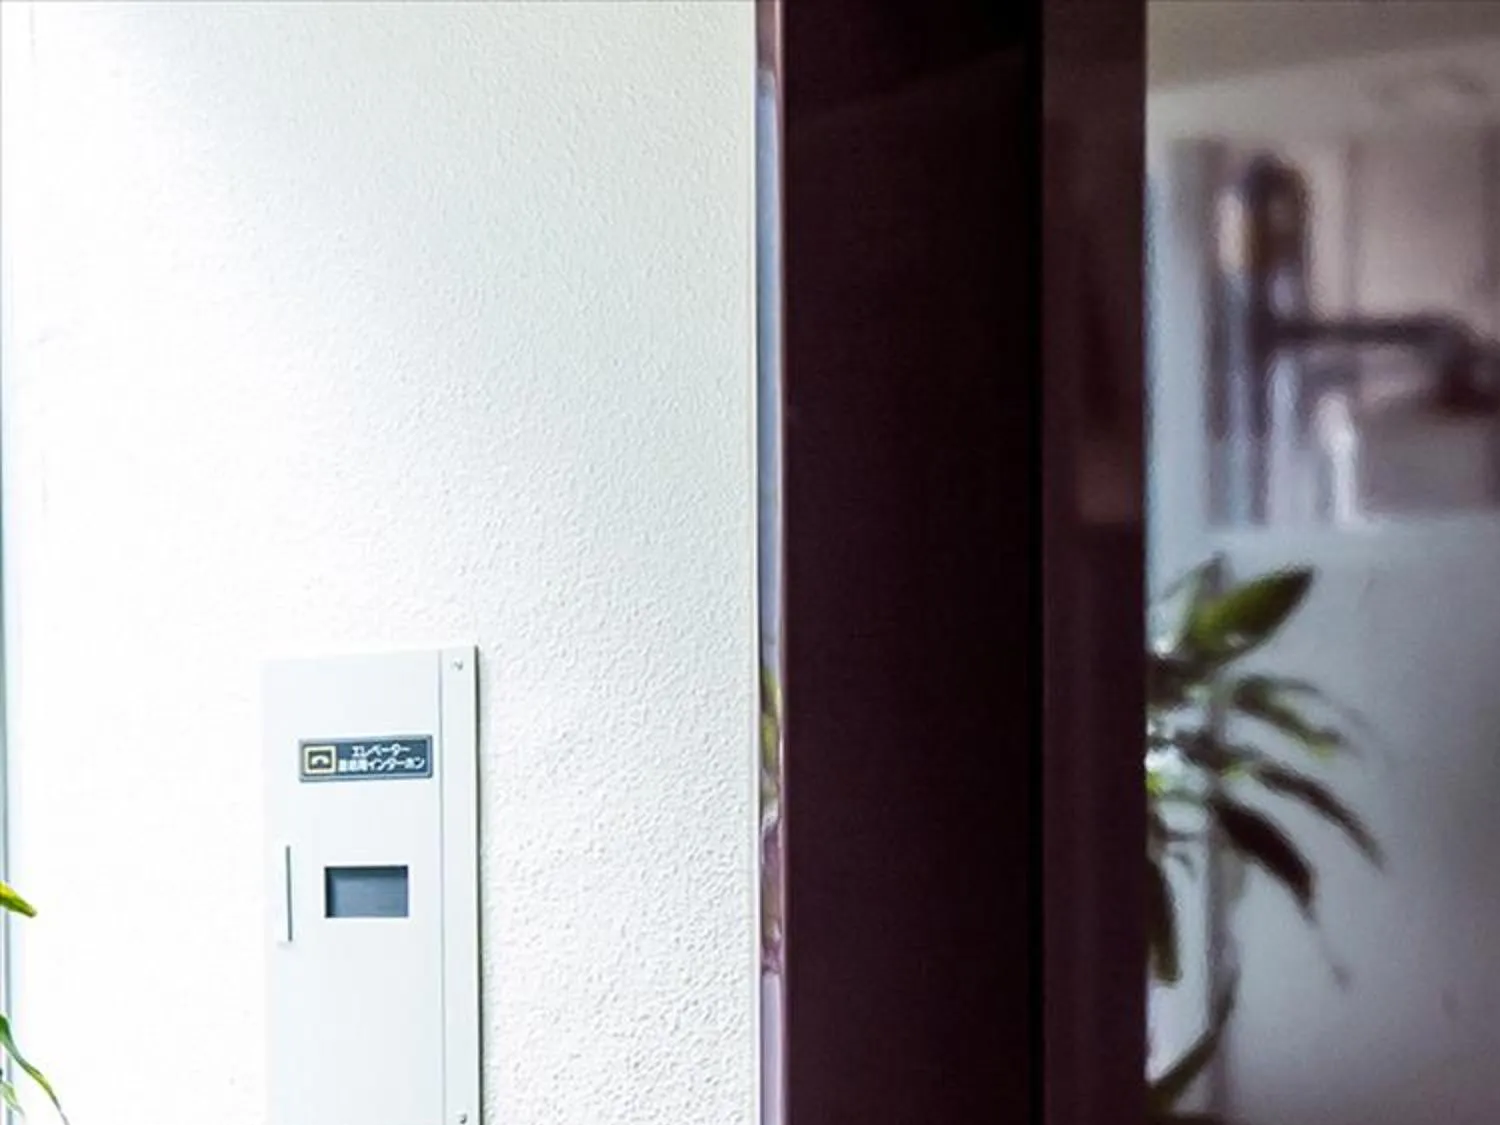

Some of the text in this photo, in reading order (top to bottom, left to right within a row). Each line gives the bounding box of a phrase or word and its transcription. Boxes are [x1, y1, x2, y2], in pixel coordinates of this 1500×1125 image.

[338, 756, 425, 772] インターホン
